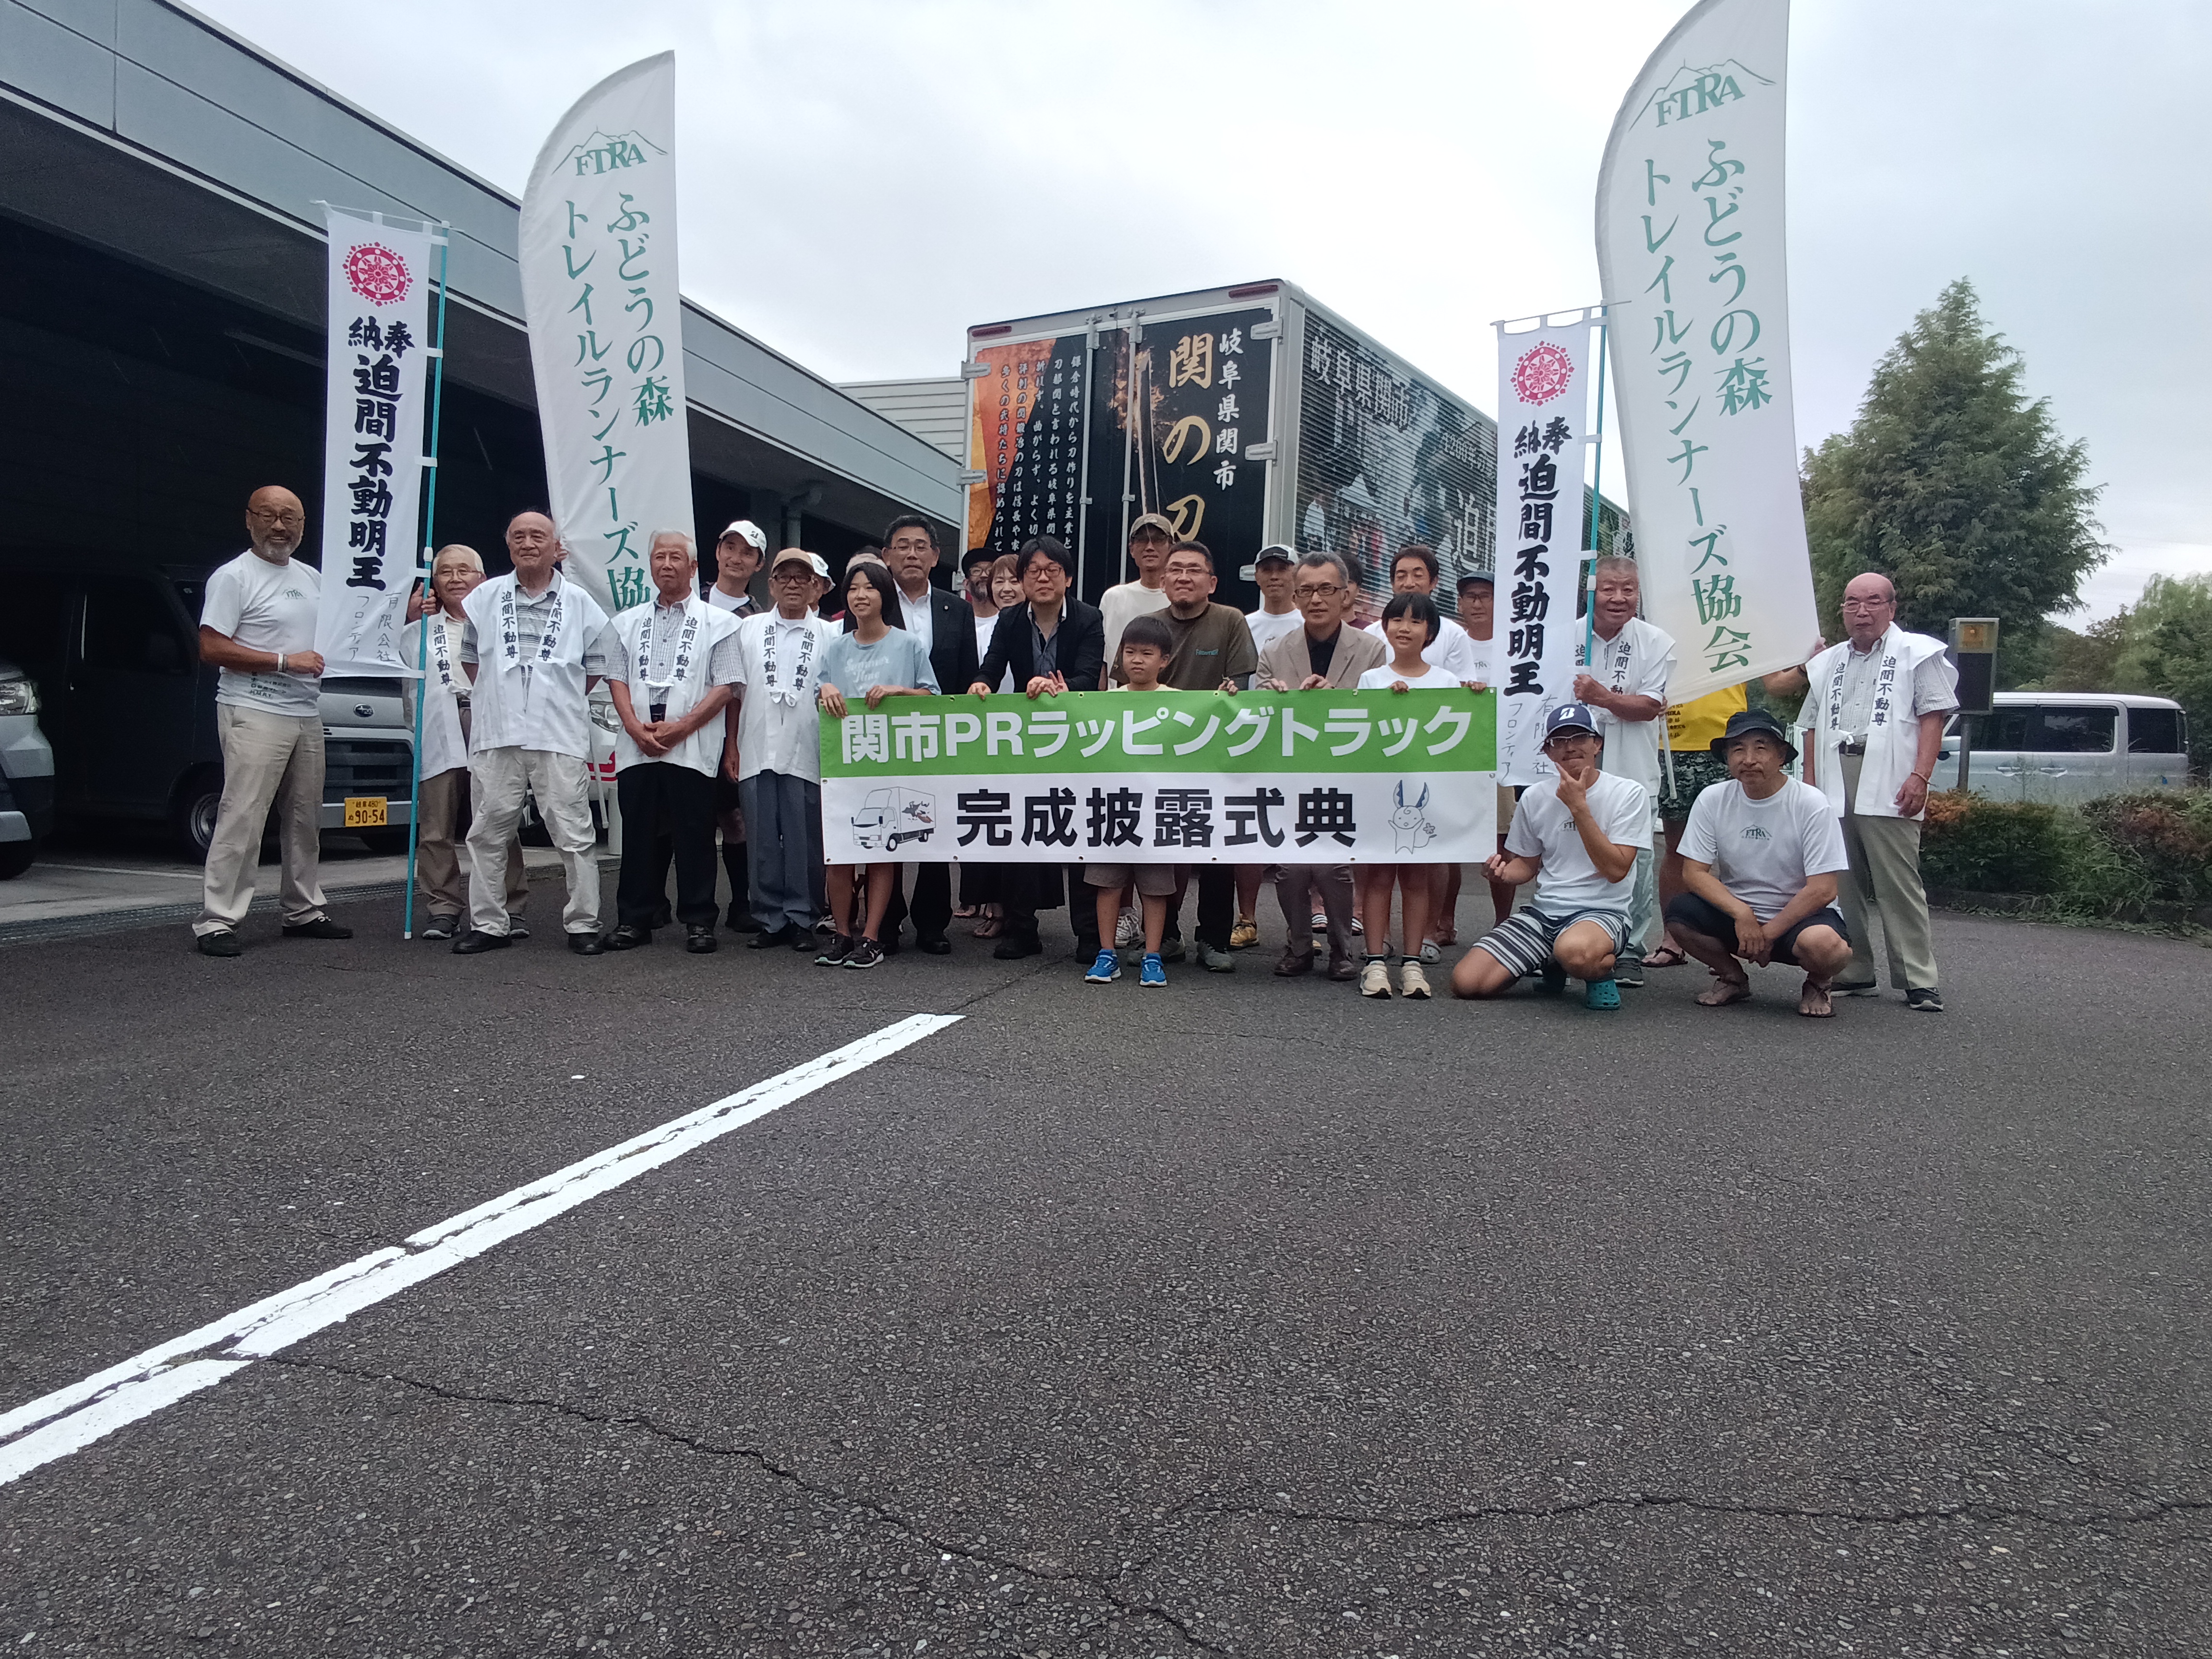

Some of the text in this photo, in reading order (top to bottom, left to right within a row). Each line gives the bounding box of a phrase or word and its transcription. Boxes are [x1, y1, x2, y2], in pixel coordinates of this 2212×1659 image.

[1656, 72, 1745, 128] FTRA
[575, 140, 647, 176] FTRA
[607, 192, 673, 427] ふどうの森
[1691, 138, 1773, 417] ふどうの森
[1162, 333, 1214, 541] 関の刀
[1214, 328, 1243, 490] 岐阜県関市
[1640, 158, 1750, 673] トレイルランナーズ協会
[346, 354, 404, 591] 迫間不動明王
[1503, 454, 1560, 697] 迫間不動明王
[349, 595, 370, 661] フロンティア
[377, 592, 402, 662] 有限会社
[433, 624, 452, 686] 迫間不動尊
[501, 590, 518, 659] 迫間不動尊
[638, 617, 652, 681] 迫間不動尊
[673, 616, 698, 681] 迫間不動尊
[763, 625, 778, 687] 迫間不動尊
[792, 629, 815, 691] 迫間不動尊
[1871, 655, 1897, 726] 迫間不動尊
[841, 704, 1472, 765] 関市PRラッピングトラック
[1501, 703, 1523, 782] フロンティア
[355, 809, 385, 824] 90-54
[957, 786, 1357, 848] 完成披露式典
